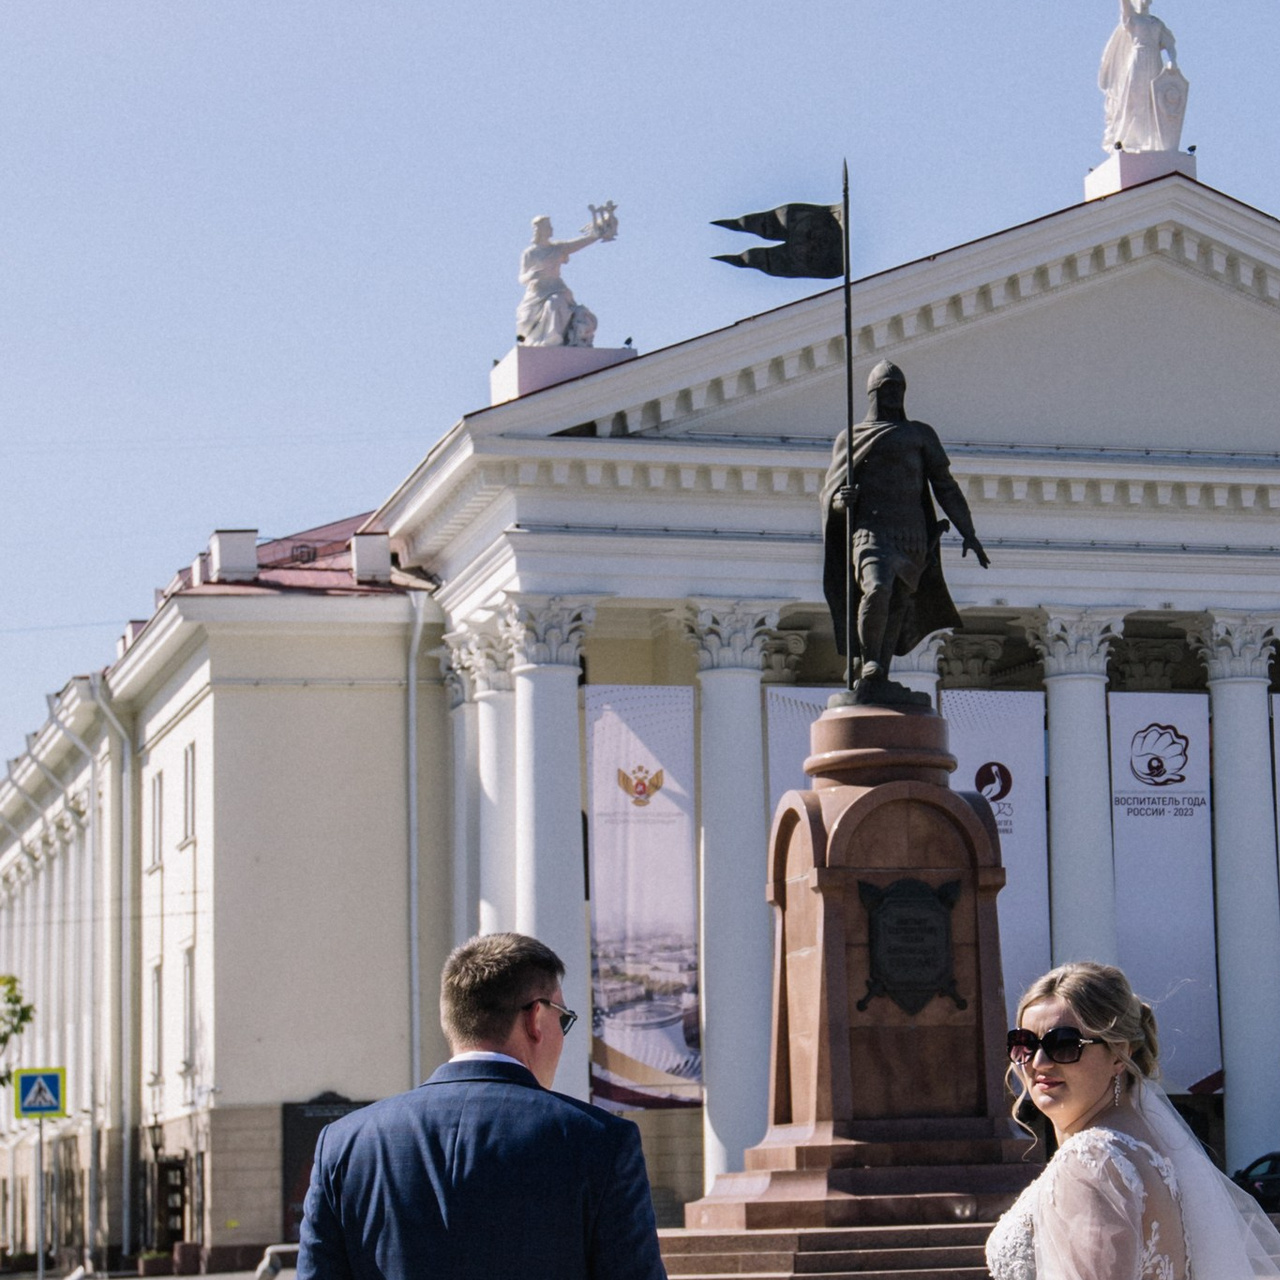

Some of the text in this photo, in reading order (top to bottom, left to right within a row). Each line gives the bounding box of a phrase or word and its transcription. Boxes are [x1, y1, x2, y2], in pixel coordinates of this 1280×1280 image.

[1114, 796, 1207, 807] ВОСПИТАТЕЛЬ ГОДА
[1127, 807, 1165, 816] РОССИИ
[1173, 807, 1194, 816] 2023
